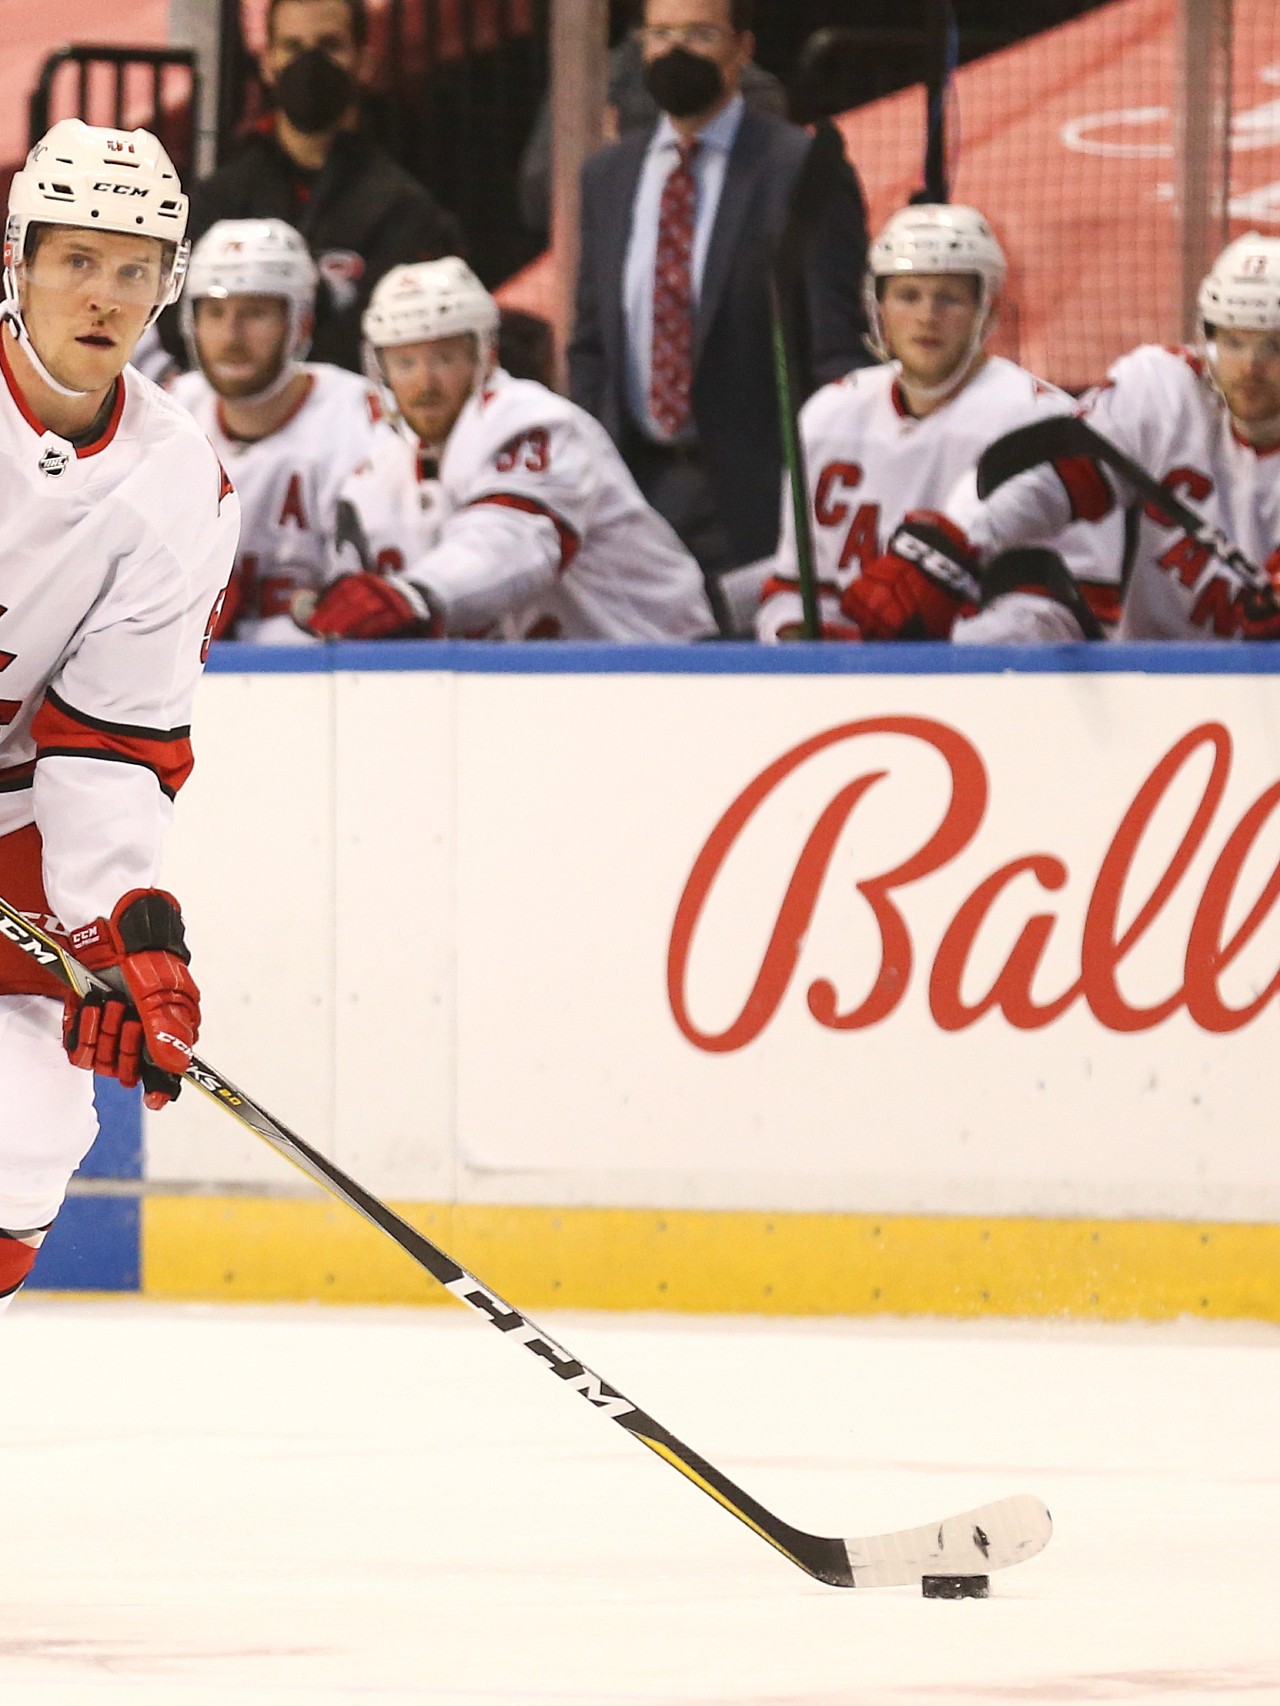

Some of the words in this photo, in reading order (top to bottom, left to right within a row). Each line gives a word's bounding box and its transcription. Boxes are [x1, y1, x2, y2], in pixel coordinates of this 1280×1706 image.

[92, 182, 151, 198] CCM
[277, 472, 312, 531] A
[72, 925, 98, 944] CCM
[444, 1270, 637, 1421] CCM
